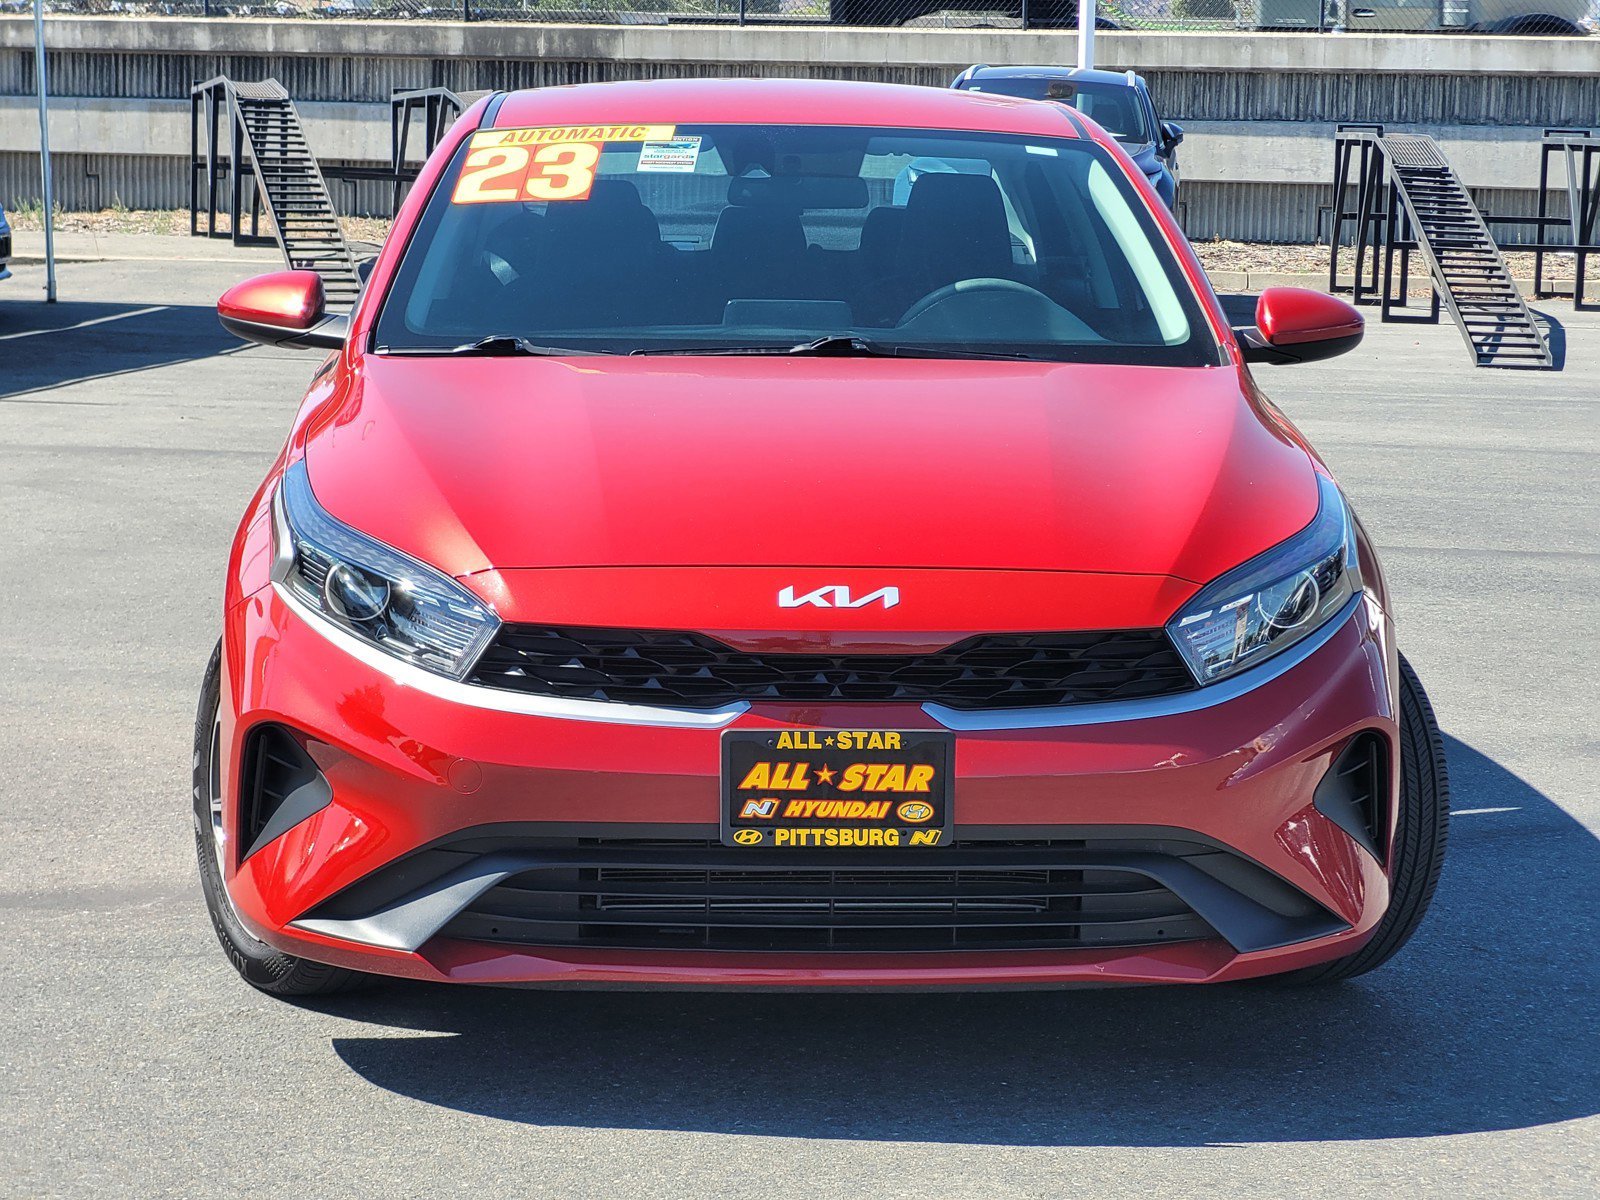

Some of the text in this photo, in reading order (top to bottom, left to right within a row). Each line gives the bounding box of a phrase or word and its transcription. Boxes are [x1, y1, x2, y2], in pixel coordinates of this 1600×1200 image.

[499, 126, 648, 144] AUTOMATIC
[454, 142, 600, 201] 23
[778, 584, 900, 609] KIA
[776, 731, 901, 750] ALL STAR
[737, 761, 935, 792] ALL STAR
[782, 799, 894, 819] HYUNDAI
[774, 828, 900, 846] PITTSBURG
